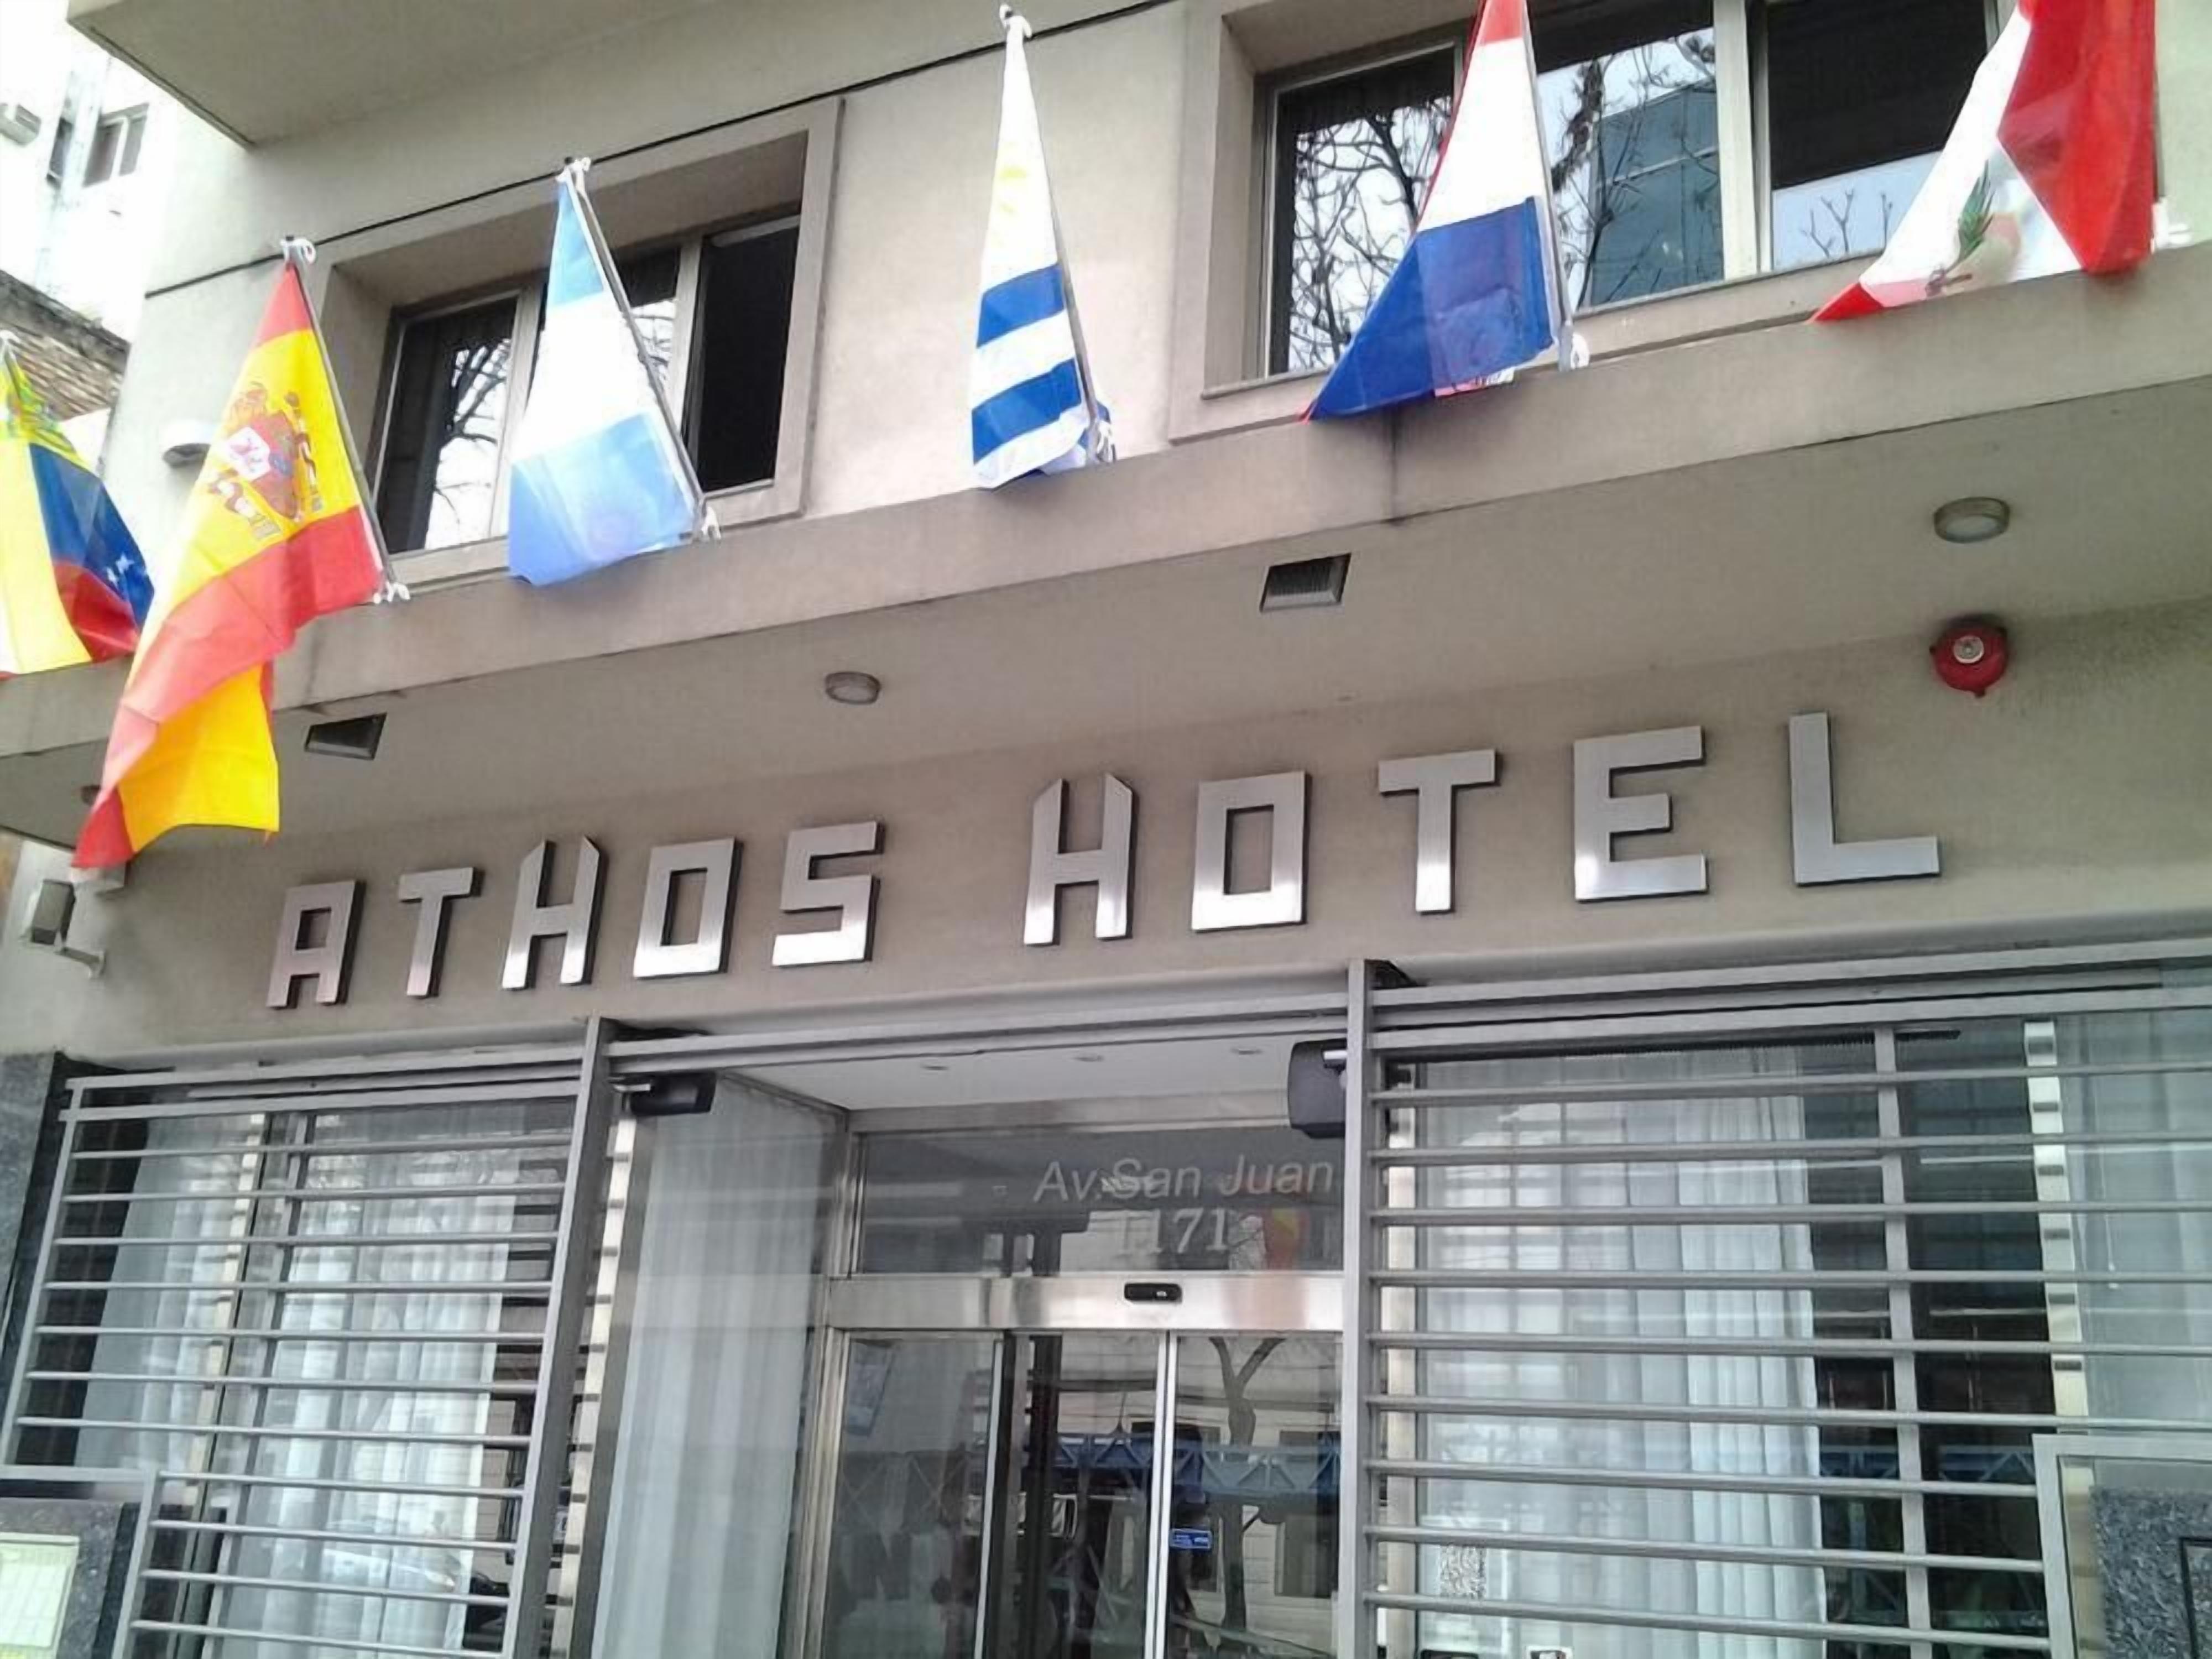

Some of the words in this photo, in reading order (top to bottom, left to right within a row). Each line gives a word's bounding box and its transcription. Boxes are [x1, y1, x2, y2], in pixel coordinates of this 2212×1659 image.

[267, 820, 880, 1008] ATHOS
[1023, 711, 1940, 945] HOTEL
[1218, 1154, 1333, 1196] Juan
